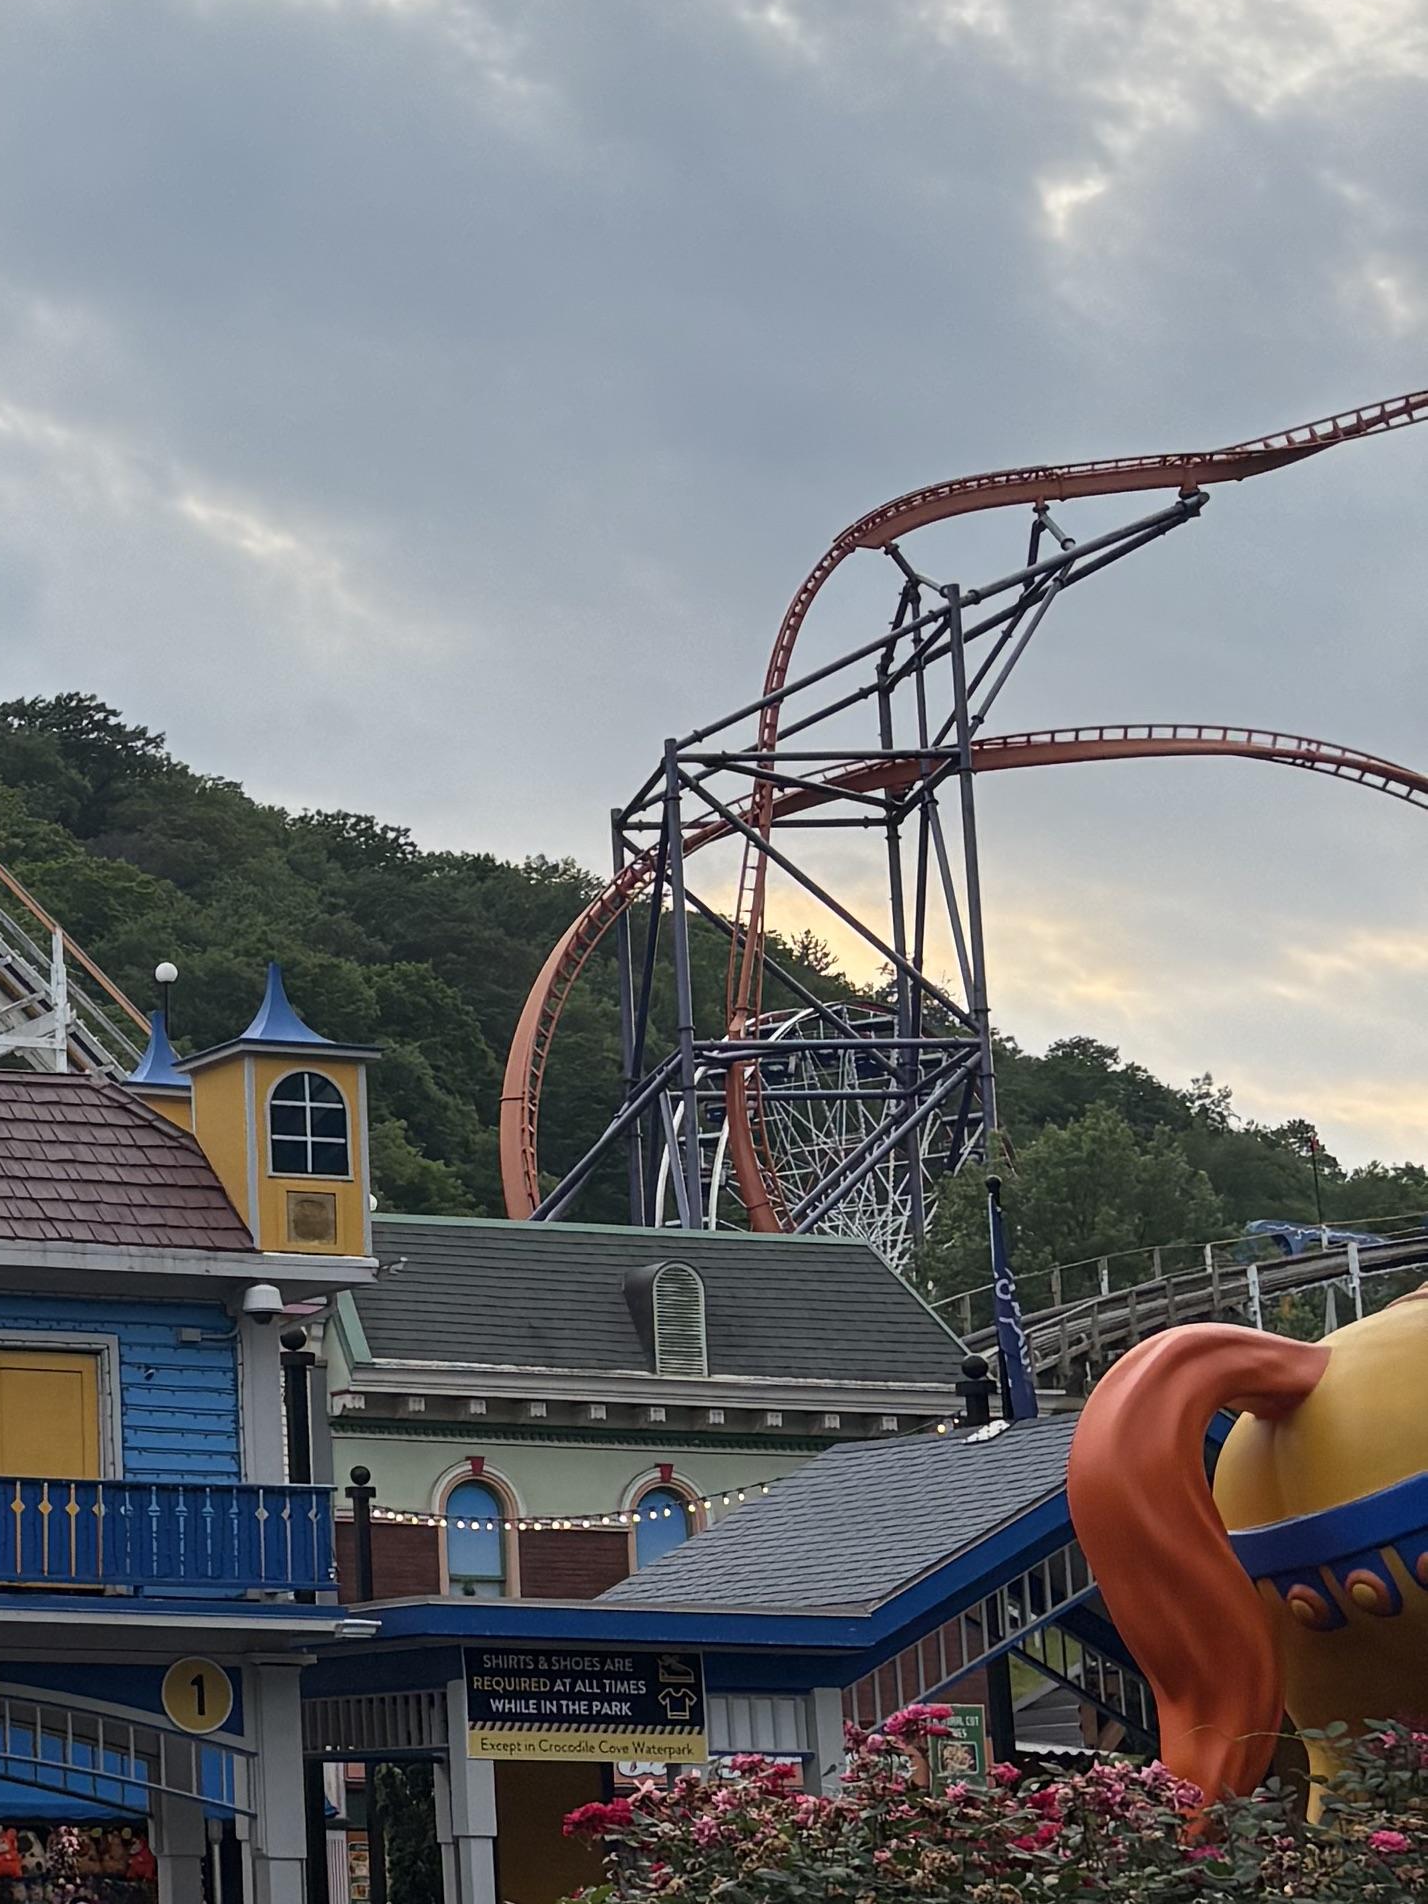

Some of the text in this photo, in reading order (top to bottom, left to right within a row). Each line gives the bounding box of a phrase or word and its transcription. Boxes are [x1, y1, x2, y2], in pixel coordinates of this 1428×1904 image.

[482, 1654, 634, 1672] SHIRTS & SHOES ARE
[190, 1673, 208, 1716] 1
[473, 1676, 647, 1694] REQUIRED AT ALL TIMES
[489, 1698, 633, 1717] WHILE IN THE PARK
[480, 1737, 694, 1759] Except in Crocodile Cove Waterpark
